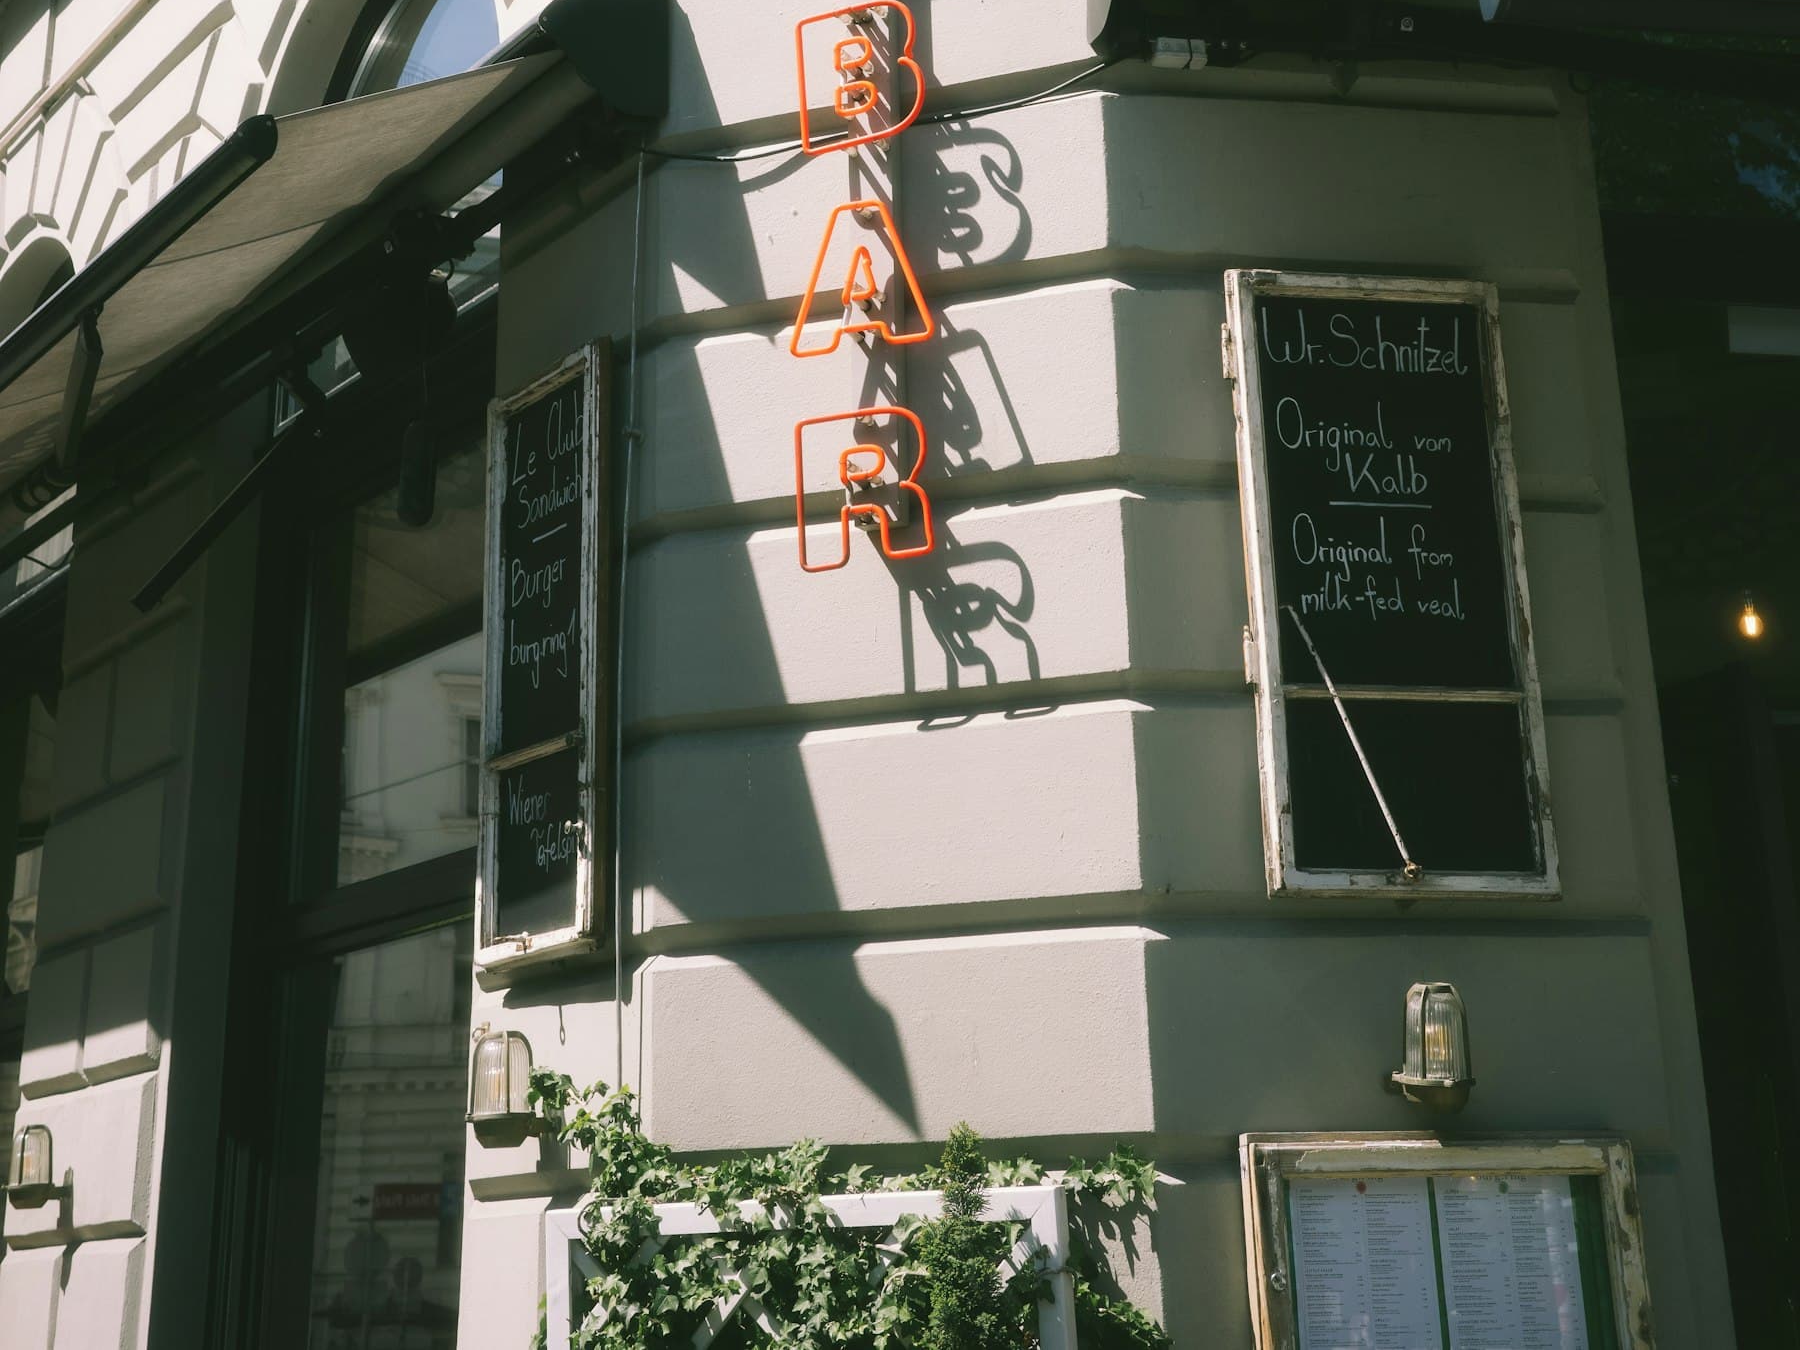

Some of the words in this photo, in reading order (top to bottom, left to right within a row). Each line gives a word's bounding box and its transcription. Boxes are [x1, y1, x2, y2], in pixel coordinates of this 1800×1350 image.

[511, 422, 537, 486] Le
[547, 389, 584, 461] Club
[1276, 396, 1393, 472] Original
[517, 450, 583, 530] Sandwich
[1345, 452, 1428, 495] Kalb
[1292, 513, 1392, 582] Original
[1407, 524, 1454, 581] from
[511, 556, 568, 609] Burger
[1301, 571, 1405, 621] milk-fed
[1417, 577, 1465, 621] veal
[507, 773, 552, 826] Wiener
